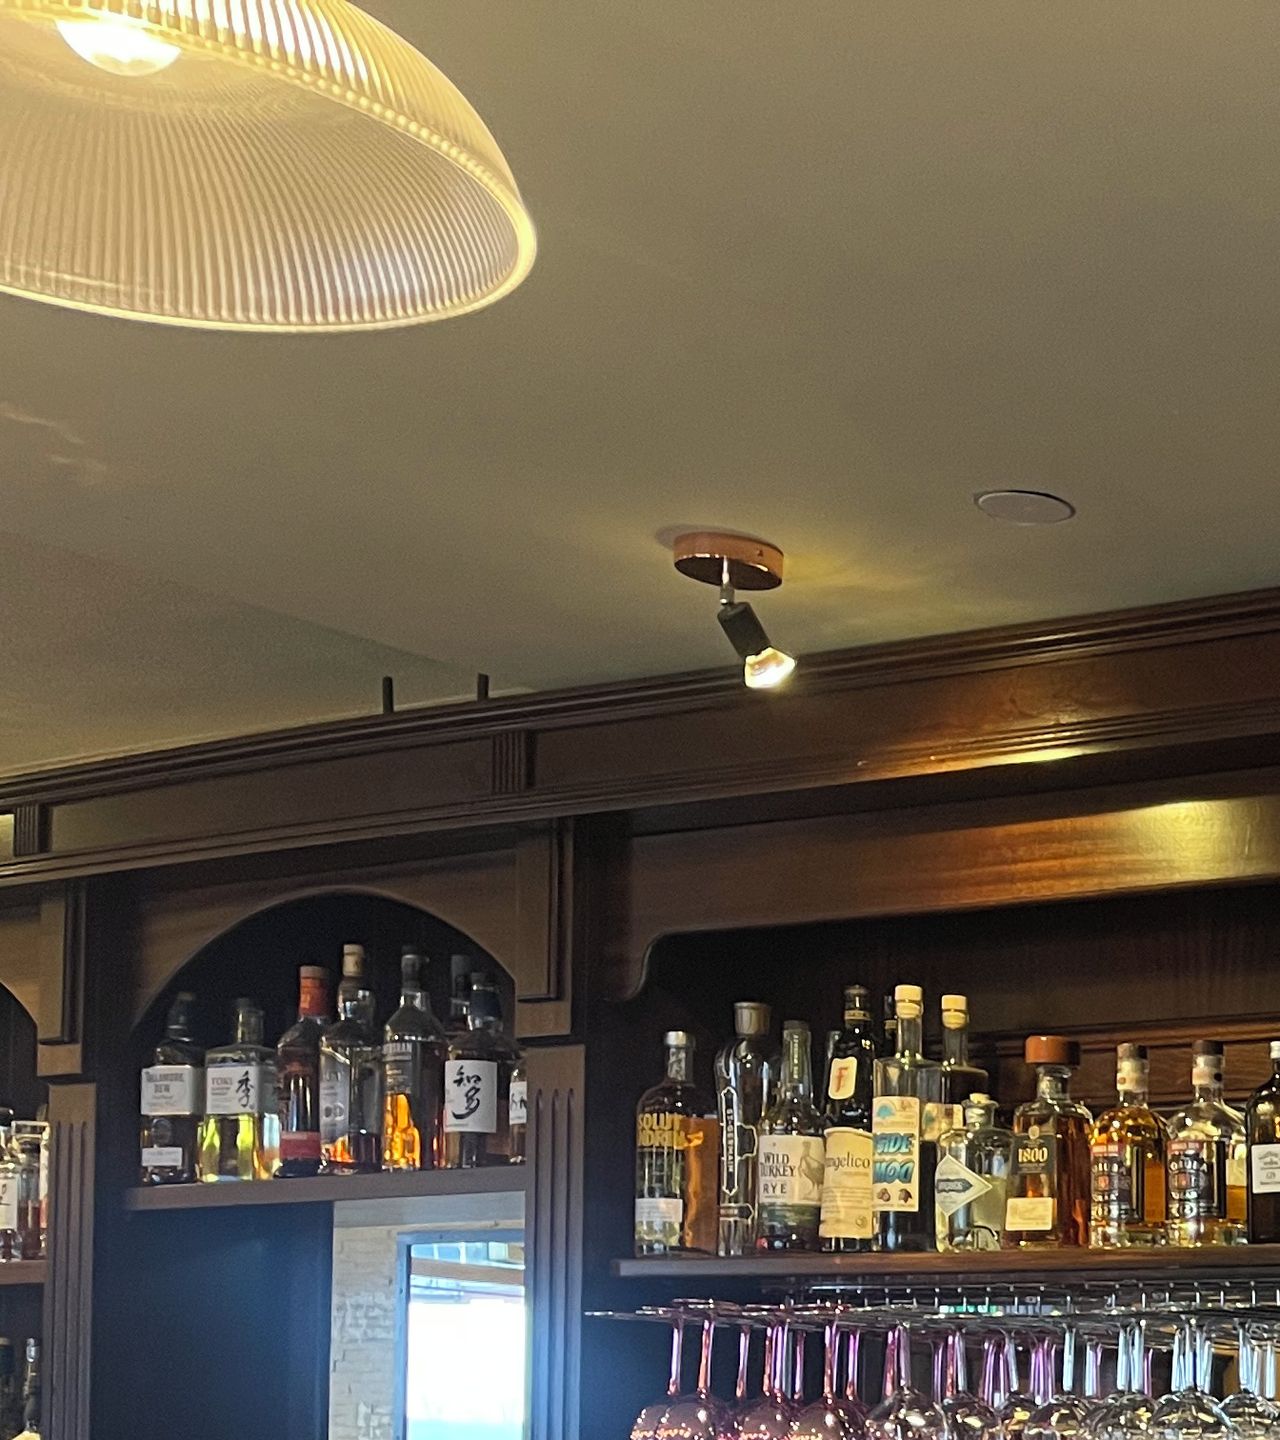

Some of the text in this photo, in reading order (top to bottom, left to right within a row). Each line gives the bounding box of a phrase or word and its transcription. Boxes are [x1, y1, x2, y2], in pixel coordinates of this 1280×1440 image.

[762, 1152, 790, 1165] WILD
[1018, 1147, 1048, 1163] 1800
[760, 1162, 797, 1178] TURKEY
[762, 1183, 788, 1194] RYE
